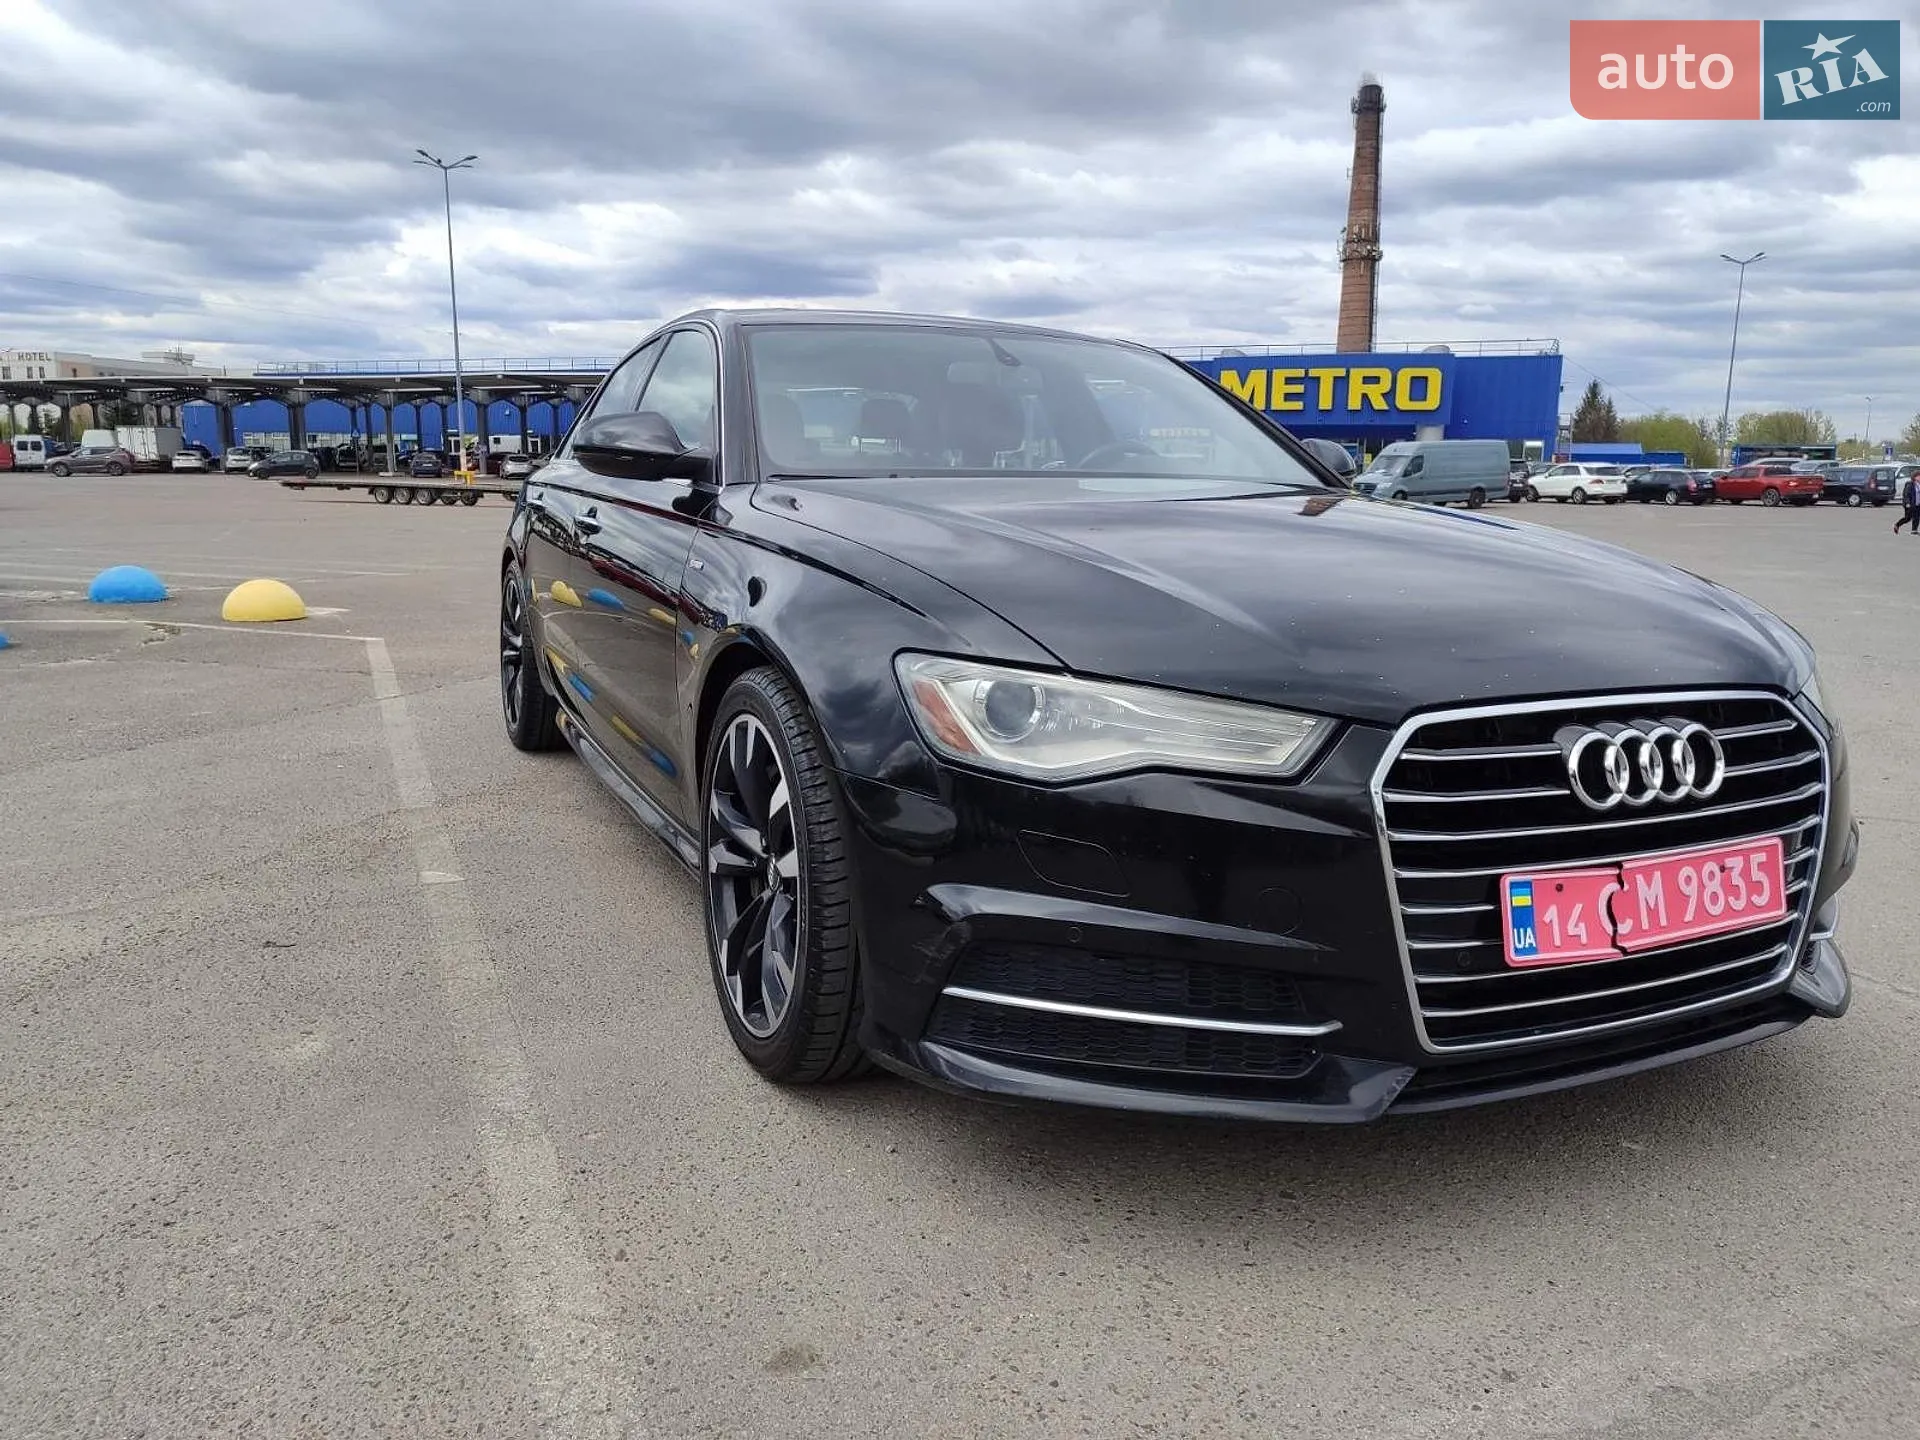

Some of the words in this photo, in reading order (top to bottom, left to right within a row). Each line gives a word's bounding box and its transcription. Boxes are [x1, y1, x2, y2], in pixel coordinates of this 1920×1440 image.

[17, 351, 53, 361] HOTEL
[1219, 367, 1443, 412] METRO
[1543, 903, 1589, 948] 14
[1677, 851, 1771, 923] 9835
[1513, 927, 1537, 949] UA
